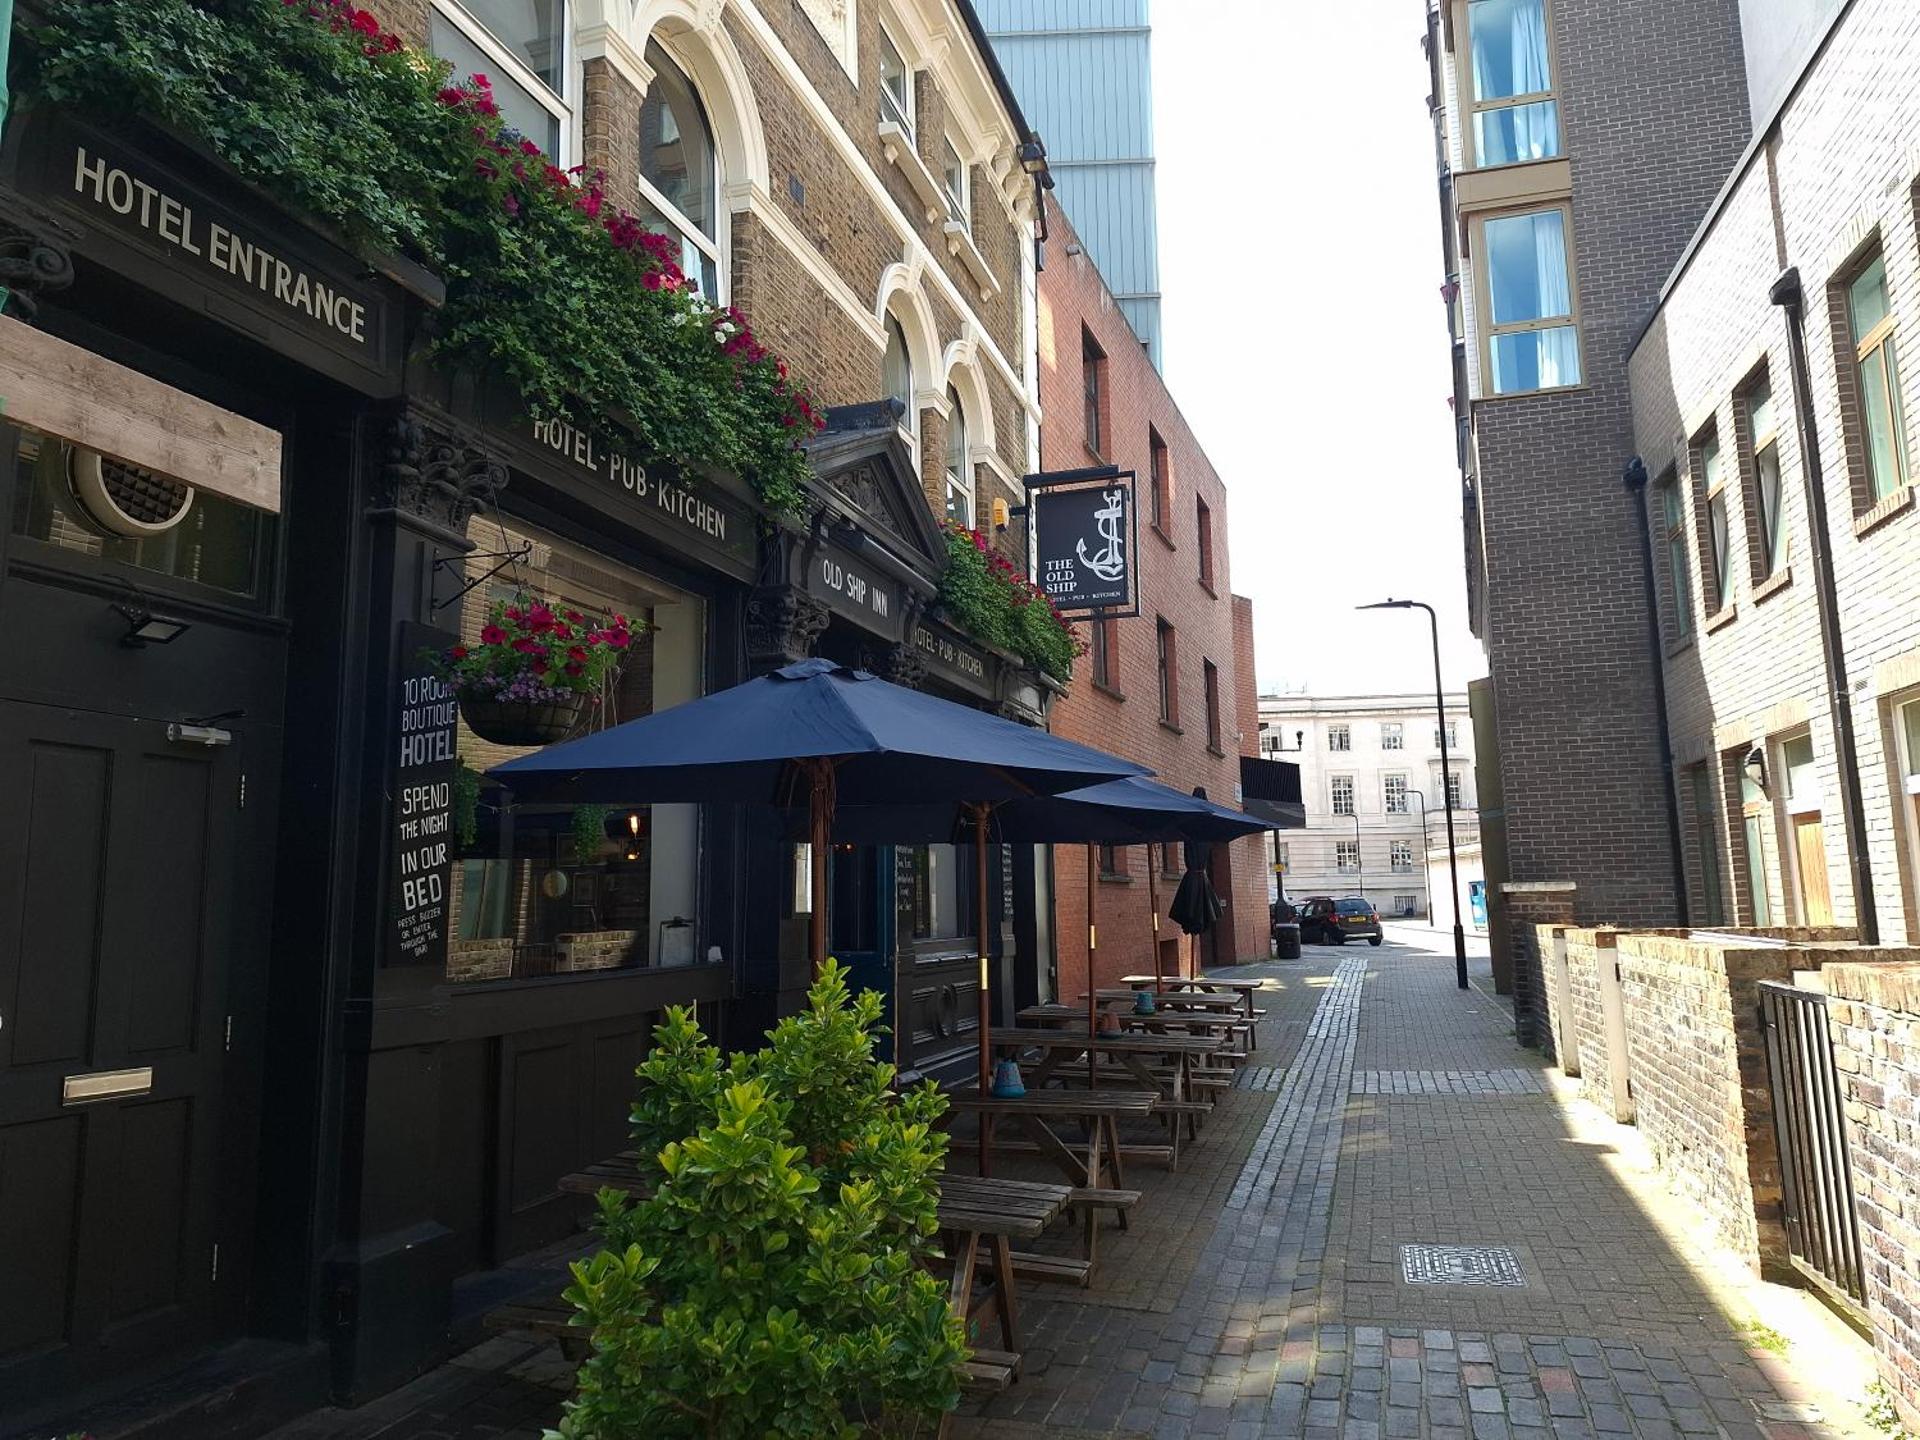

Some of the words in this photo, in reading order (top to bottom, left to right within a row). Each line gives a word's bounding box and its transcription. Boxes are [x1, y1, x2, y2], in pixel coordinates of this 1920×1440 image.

[74, 147, 201, 256] HOTEL
[209, 223, 366, 343] ENTRANCE
[609, 453, 648, 497] PUB
[658, 478, 725, 541] KITCHEN
[1045, 558, 1074, 571] THE
[1046, 571, 1075, 582] OLD
[823, 558, 843, 591] OLD
[846, 572, 866, 605] SHIP
[872, 586, 888, 618] INN
[1046, 582, 1077, 594] SHIP
[939, 639, 953, 662] PUB
[403, 678, 418, 706] 10
[402, 701, 456, 732] BOUTIQUE
[400, 729, 454, 768] HOTEL
[402, 782, 449, 815] SPEND
[400, 820, 418, 840] THE
[420, 812, 449, 836] NIGHT
[401, 850, 418, 875] IN
[420, 842, 447, 869] OUR
[402, 873, 442, 911] BED
